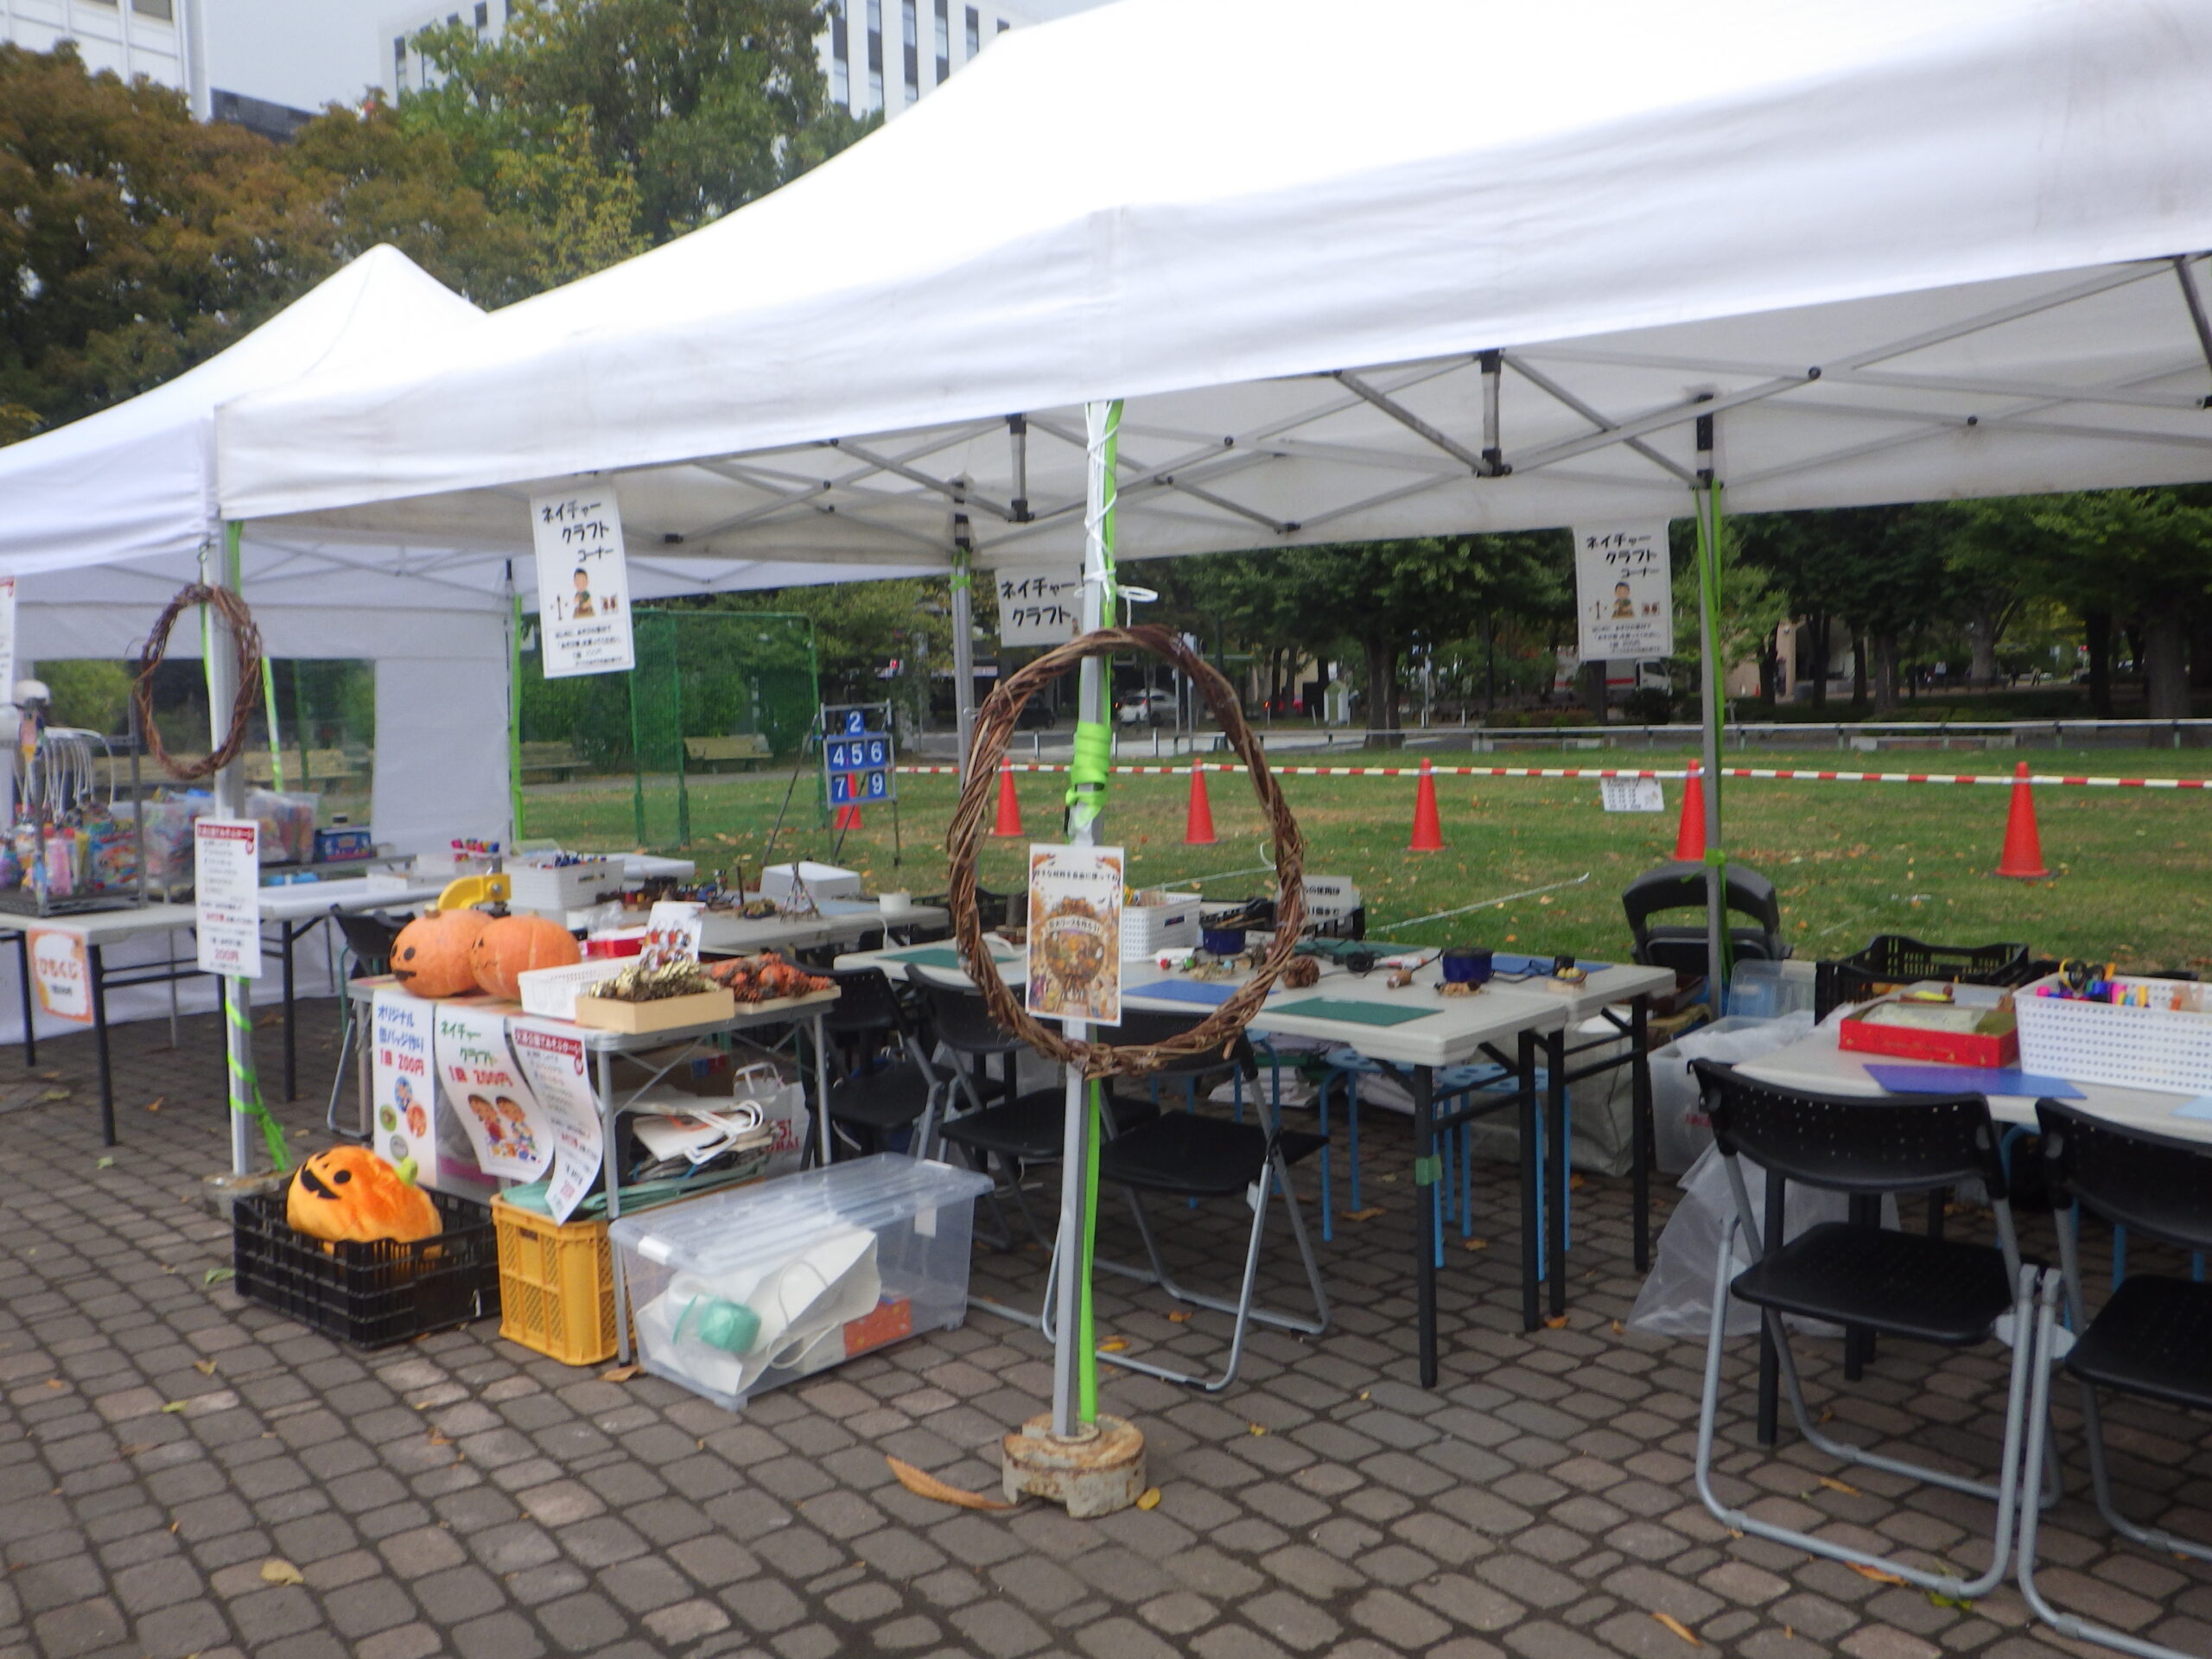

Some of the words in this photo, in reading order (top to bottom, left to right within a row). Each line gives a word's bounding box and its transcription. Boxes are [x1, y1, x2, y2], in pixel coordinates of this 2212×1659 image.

[541, 499, 601, 524] ネイチャー
[562, 520, 610, 544] クラフト
[1586, 532, 1652, 550] ネイチャー
[577, 546, 614, 563] コーナー
[1605, 549, 1658, 566] クラフト
[1621, 567, 1661, 578] コーナー
[1001, 577, 1076, 600] ネイチャー
[1012, 606, 1071, 627] クラフト
[849, 710, 861, 734] 2
[833, 745, 844, 767] 4
[851, 742, 863, 766] 5
[871, 741, 882, 763] 6
[835, 777, 846, 799] 7
[872, 772, 883, 795] 9
[378, 1004, 415, 1028] オリジナル
[441, 1020, 482, 1041] ネイチャー
[398, 1053, 424, 1077] 200円
[460, 1046, 498, 1066] クラフト
